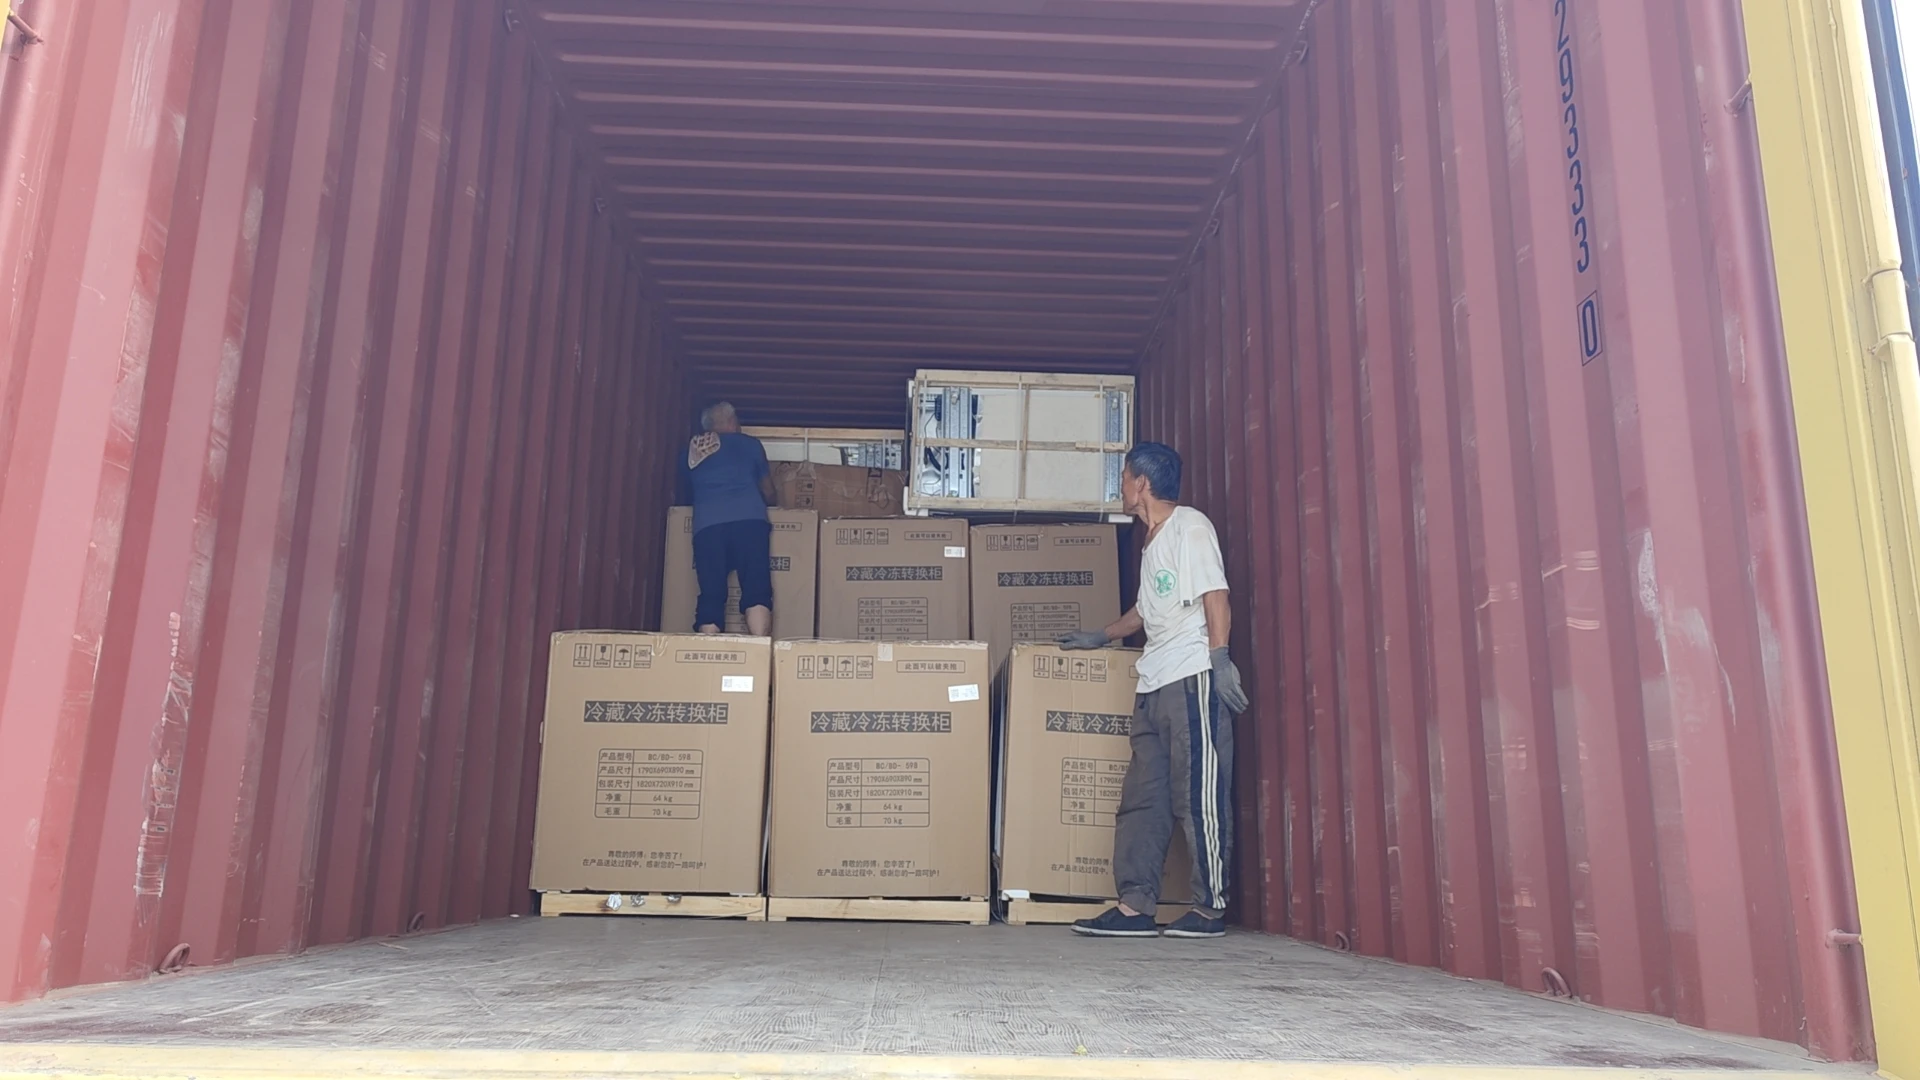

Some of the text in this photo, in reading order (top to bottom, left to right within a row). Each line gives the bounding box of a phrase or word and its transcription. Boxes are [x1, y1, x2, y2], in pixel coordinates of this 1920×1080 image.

[846, 567, 942, 580] 冷藏冷冻转换柜
[998, 572, 1093, 586] 冷藏冷冻转换柜
[585, 702, 728, 724] 冷藏冷冻转换柜
[811, 712, 951, 732] 冷藏冷冻转换柜
[600, 752, 632, 762] 产品型号
[829, 762, 860, 771] 产品型号
[1064, 761, 1094, 770] 产品型号
[600, 766, 631, 775] 产品尺寸
[829, 775, 860, 784] 产品尺寸
[1063, 774, 1093, 784] 产品尺寸
[599, 780, 630, 789] 包装尺寸
[829, 789, 860, 798] 包装尺寸
[1063, 787, 1093, 797] 包装尺寸
[605, 793, 621, 802] 净重
[836, 803, 852, 811] 净重
[1070, 801, 1086, 810] 净重
[604, 807, 620, 816] 毛重
[836, 817, 852, 825] 毛重
[883, 817, 892, 825] 70
[1070, 814, 1085, 823] 毛重
